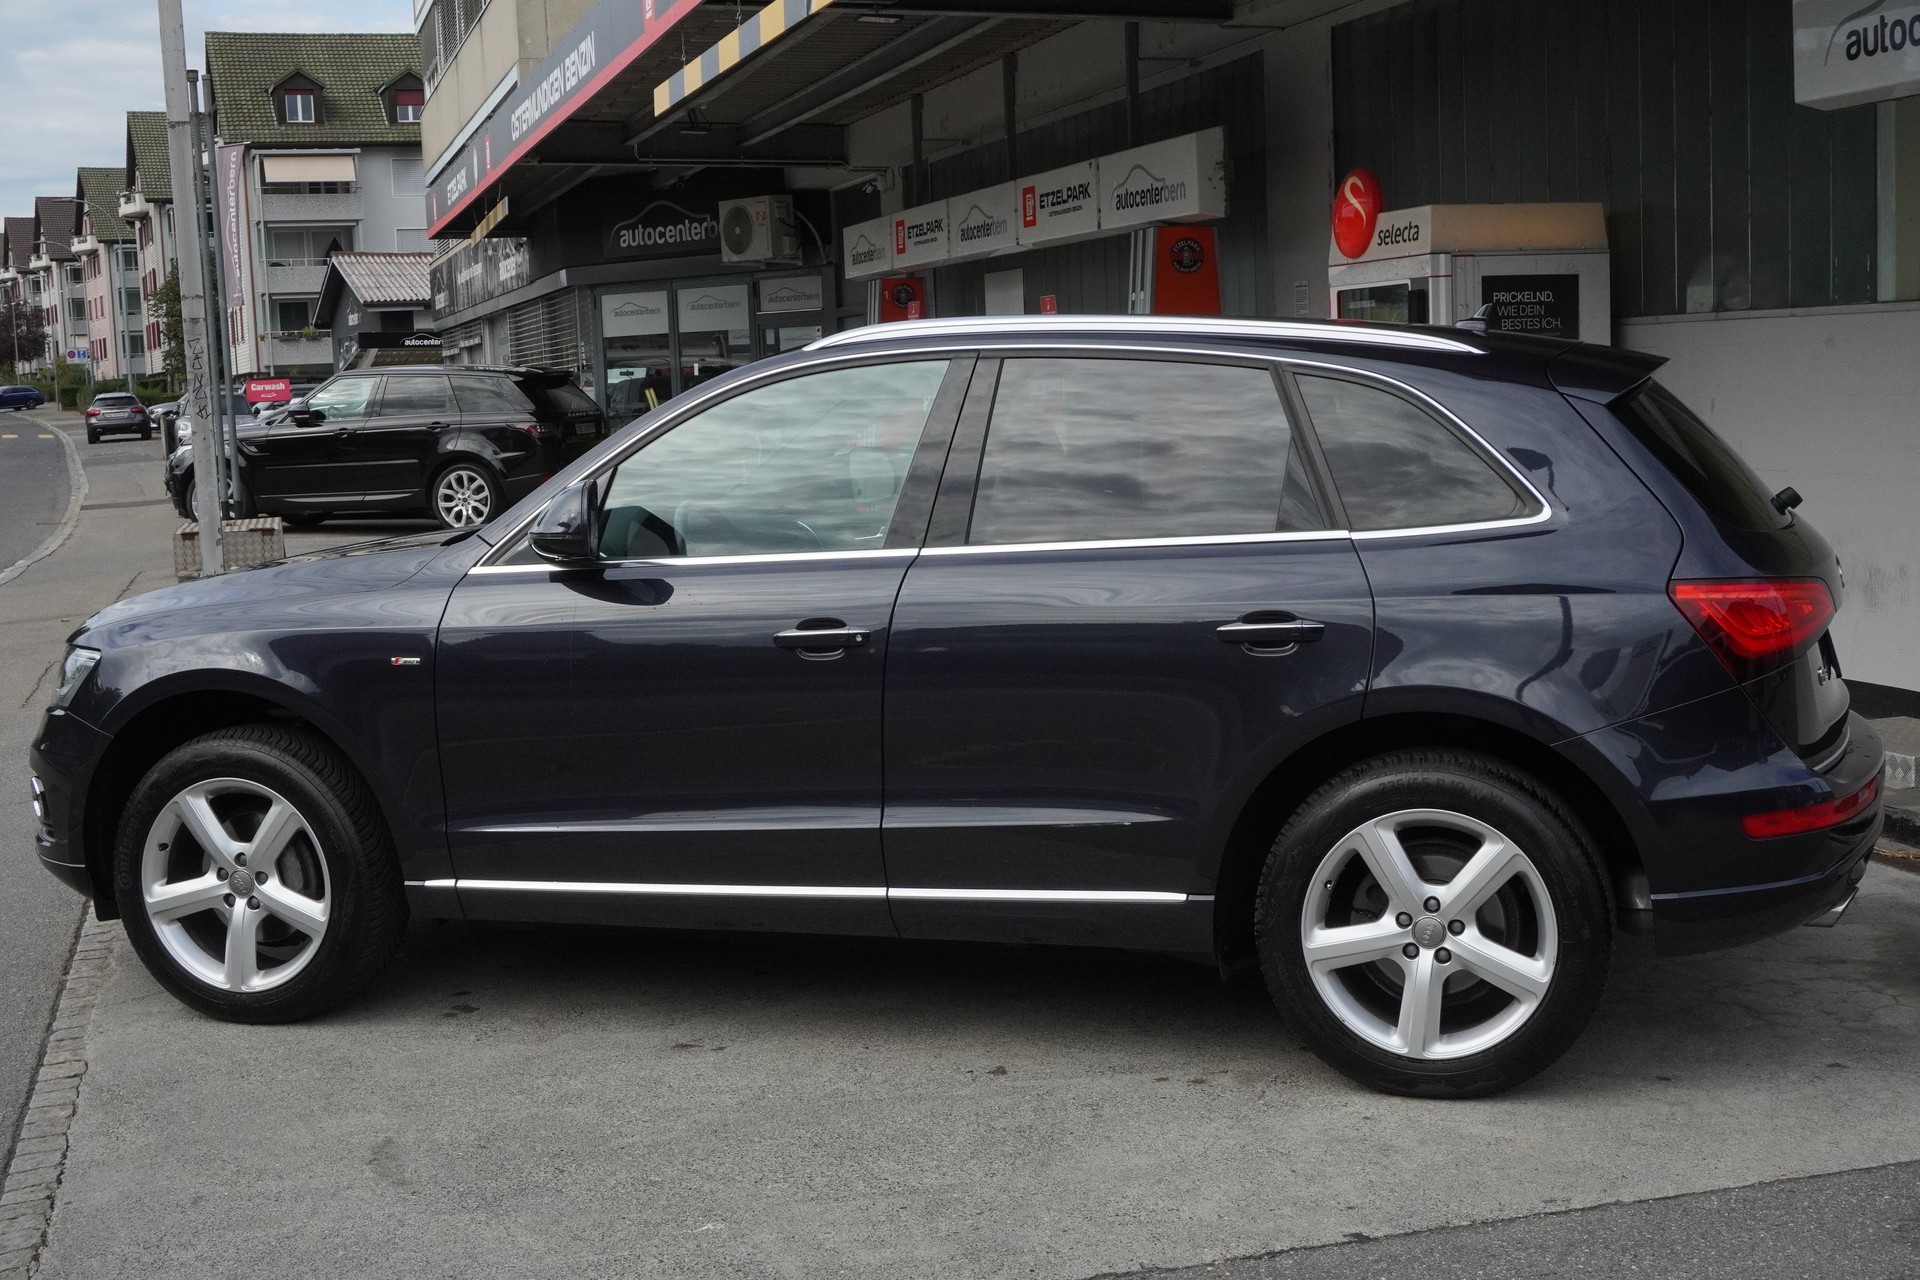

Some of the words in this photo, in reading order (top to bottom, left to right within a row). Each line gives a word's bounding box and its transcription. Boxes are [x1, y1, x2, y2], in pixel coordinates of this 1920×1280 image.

[511, 62, 564, 141] OSTERMUNDIGEN
[564, 31, 596, 91] BENZIN
[1039, 181, 1092, 210] ETZELPARK
[1115, 177, 1187, 211] autocenterbern
[227, 151, 241, 278] autocenterbern
[619, 214, 720, 248] autocenterb
[907, 218, 944, 240] ETZELPARK
[960, 216, 1008, 243] autocenterbern
[1377, 221, 1420, 247] selecta
[851, 246, 886, 266] autocenterbern
[690, 299, 741, 311] autocenterbern
[767, 291, 820, 304] autocenterbern
[613, 306, 661, 318] autocenterbern
[1497, 305, 1518, 316] WIE
[1520, 304, 1545, 316] DEIN
[1502, 318, 1541, 330] BESTES
[1541, 317, 1562, 329] ICH.
[404, 338, 445, 346] autocenter
[251, 382, 285, 391] Carwash
